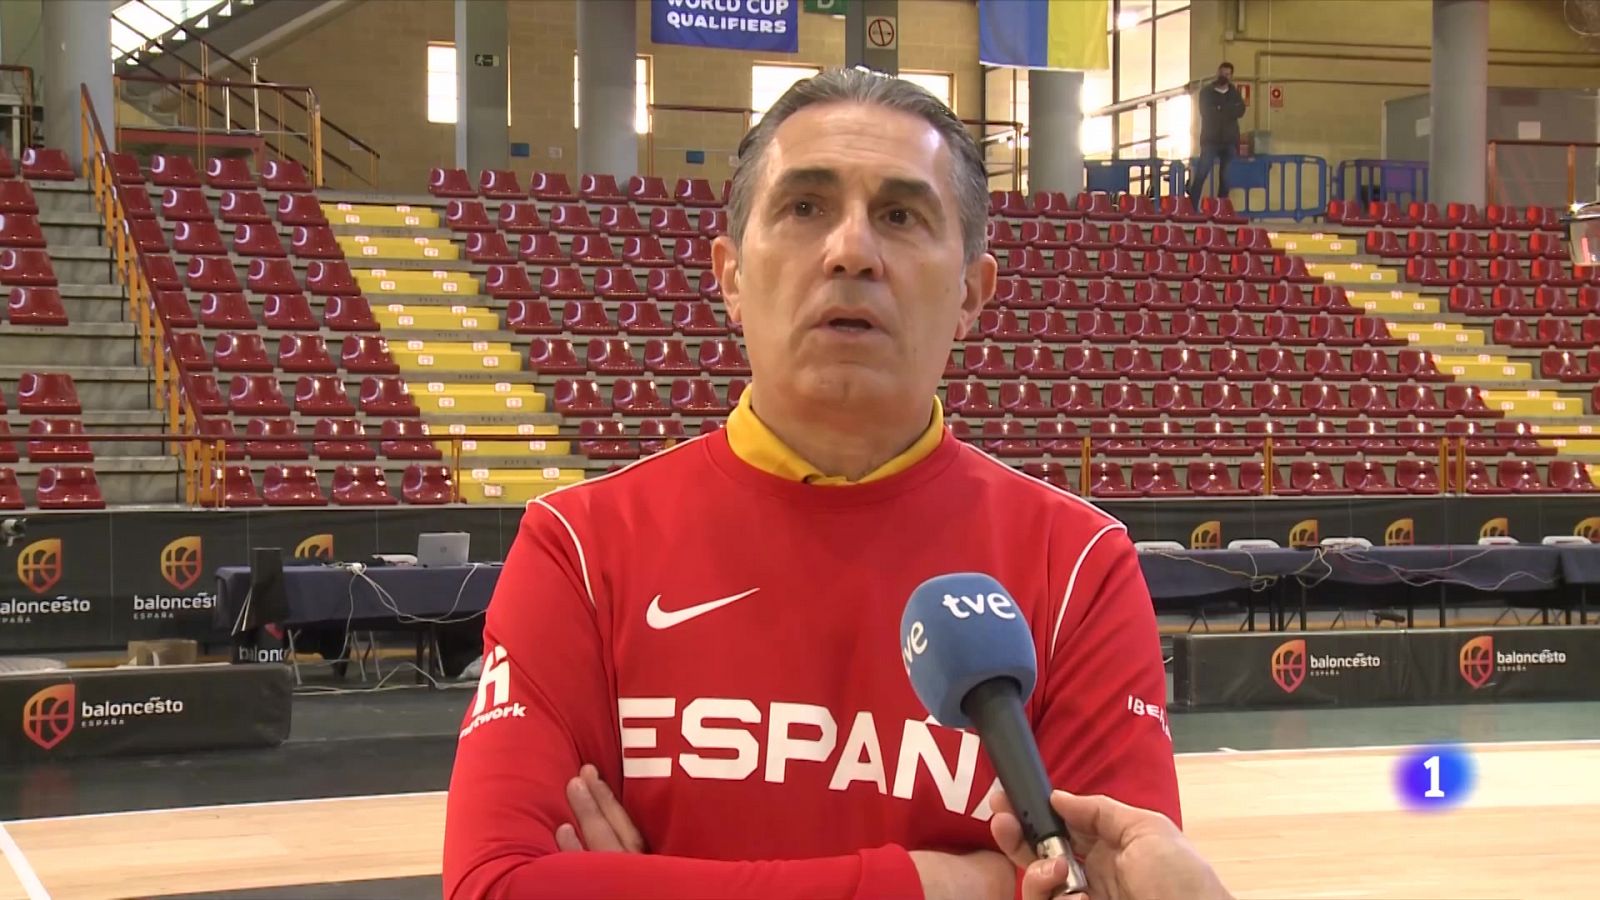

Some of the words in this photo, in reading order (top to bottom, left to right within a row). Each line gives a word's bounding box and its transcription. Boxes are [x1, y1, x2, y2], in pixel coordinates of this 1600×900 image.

[746, 0, 789, 15] CUP
[667, 11, 787, 33] QUALIFIERS
[0, 596, 91, 614] aloncesto
[942, 593, 1016, 619] tve
